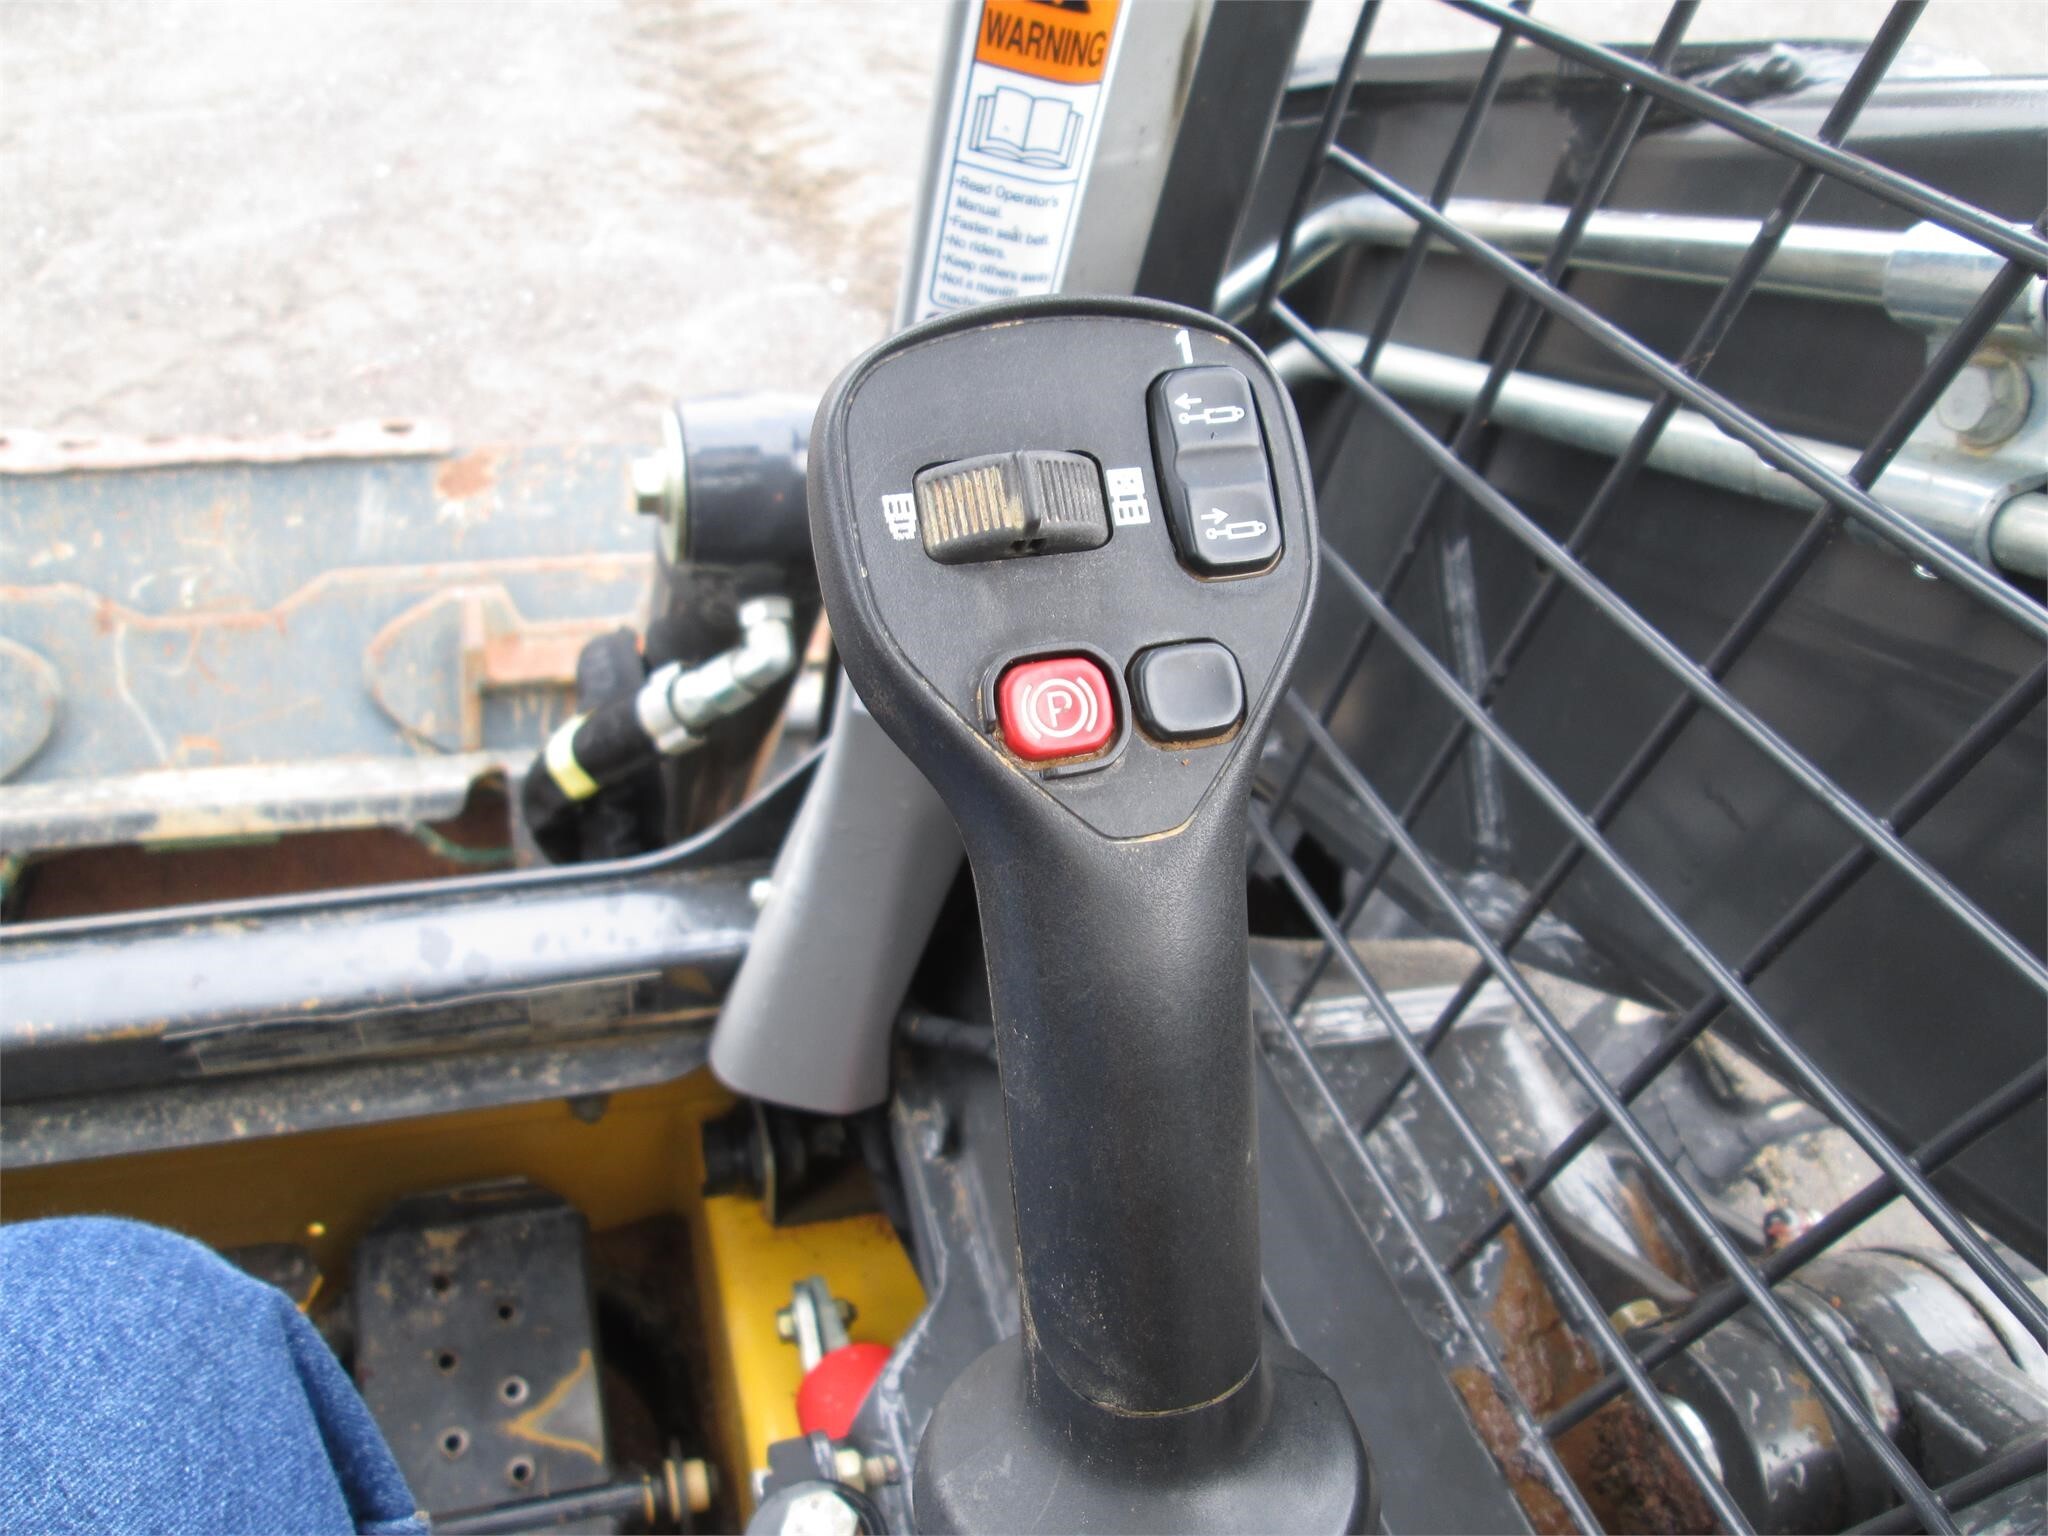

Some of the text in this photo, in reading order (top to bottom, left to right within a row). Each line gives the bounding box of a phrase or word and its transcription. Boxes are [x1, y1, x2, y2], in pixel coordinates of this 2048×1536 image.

[984, 7, 1107, 67] WARNING
[1175, 329, 1194, 365] 1
[1046, 690, 1073, 728] P
